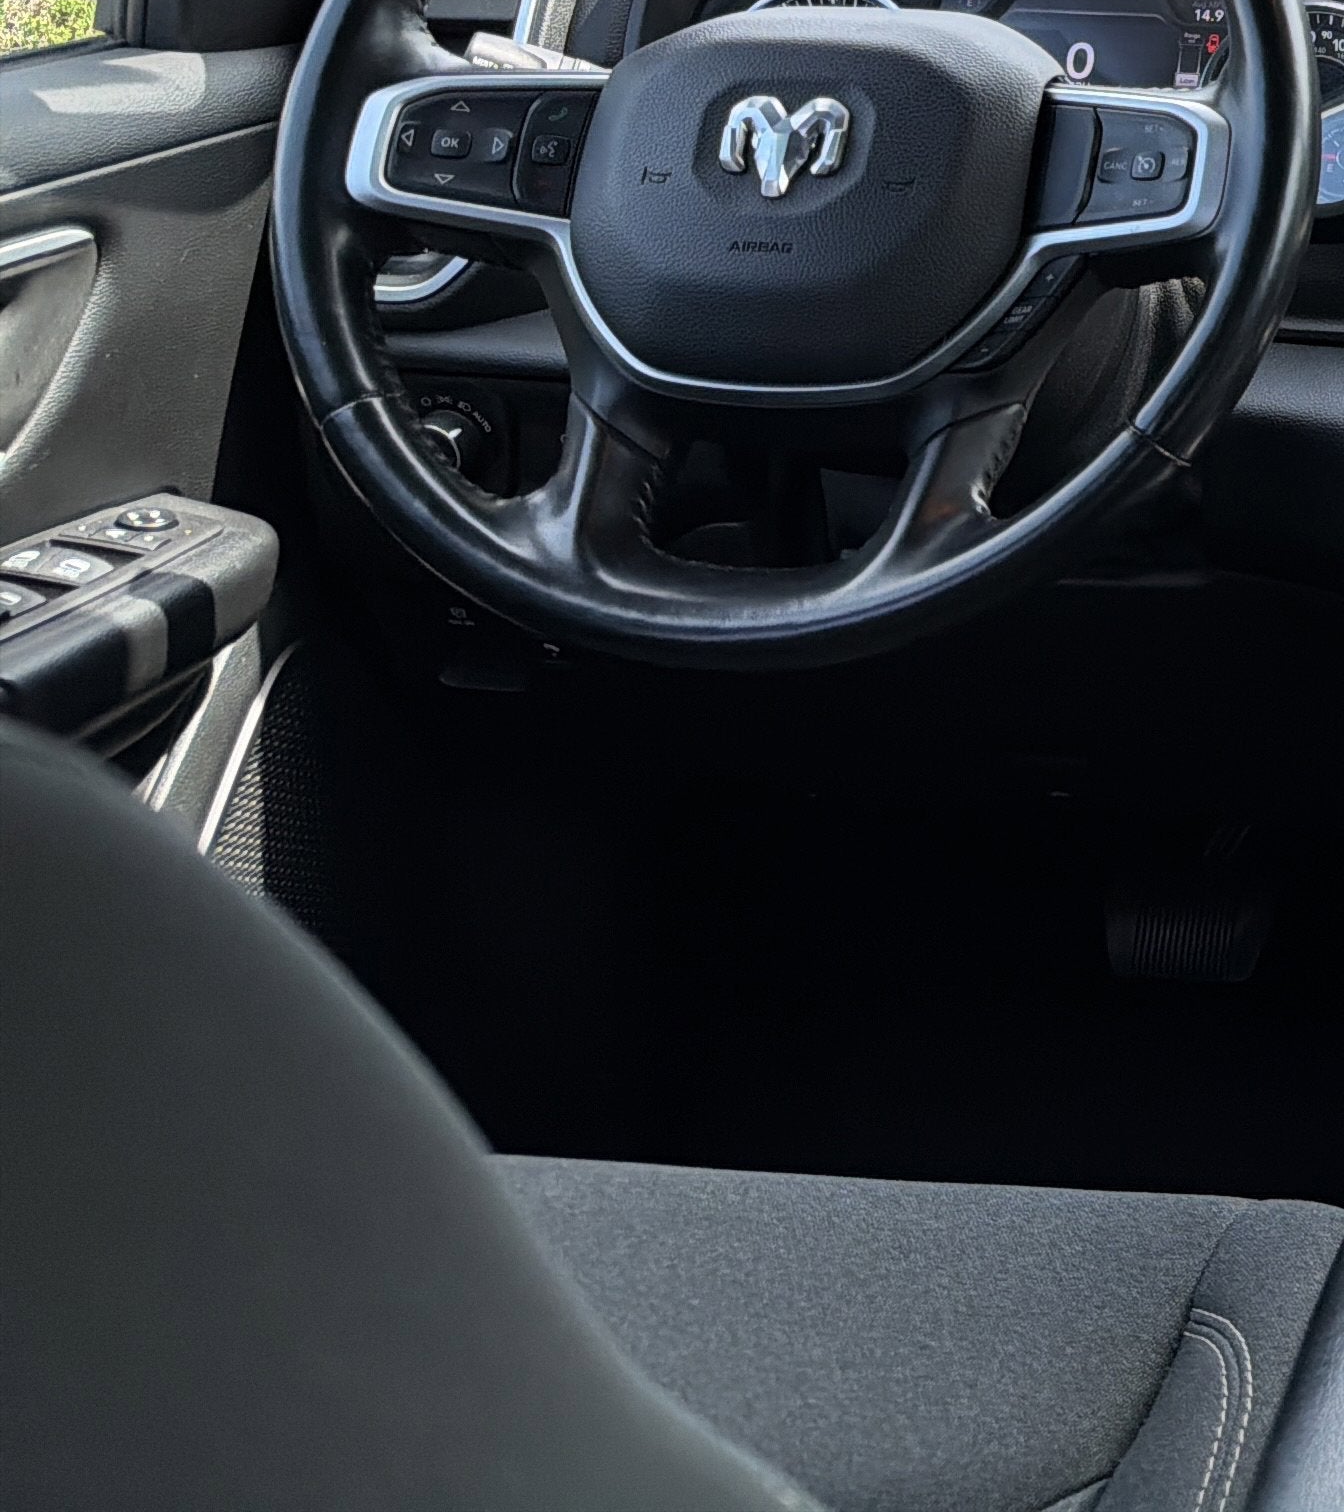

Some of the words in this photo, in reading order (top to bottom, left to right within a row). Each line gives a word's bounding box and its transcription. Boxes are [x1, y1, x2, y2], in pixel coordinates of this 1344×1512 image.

[1194, 9, 1225, 22] 14.9
[1321, 30, 1333, 39] 90
[1066, 41, 1095, 80] 0
[441, 137, 459, 150] OK
[1103, 161, 1128, 170] CANC
[728, 239, 794, 254] AIRBAG
